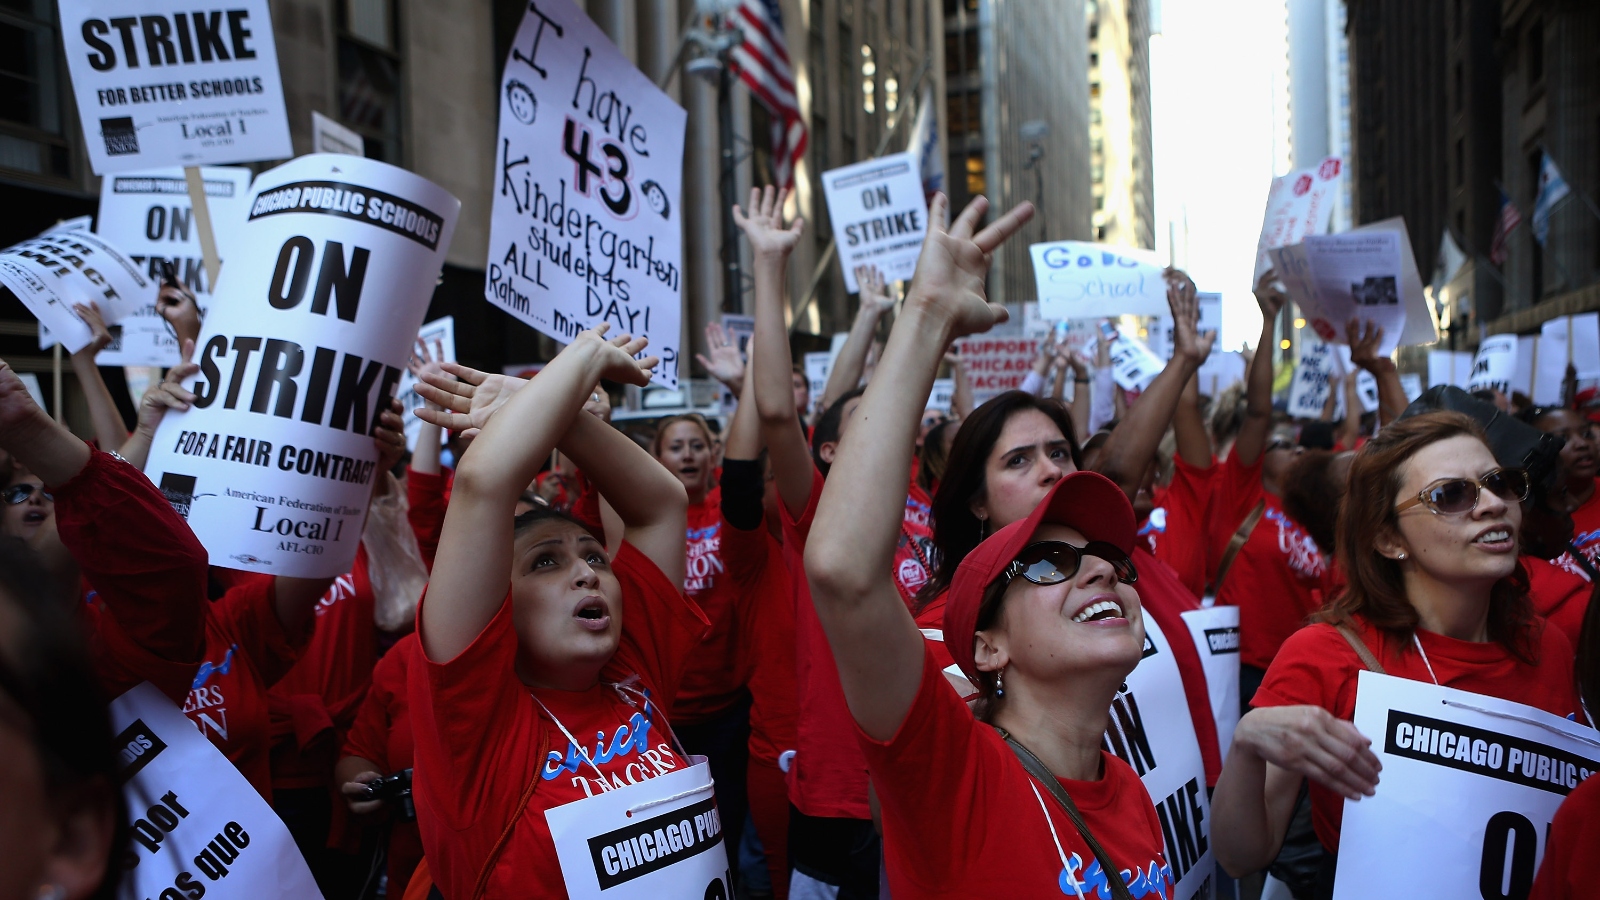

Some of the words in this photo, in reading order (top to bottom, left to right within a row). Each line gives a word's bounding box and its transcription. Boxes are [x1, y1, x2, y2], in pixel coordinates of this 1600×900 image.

[81, 10, 257, 72] STRIKE
[512, 2, 563, 79] I
[98, 89, 127, 106] FOR
[131, 82, 187, 103] BETTER
[190, 77, 263, 99] SCHOOLS
[572, 47, 650, 158] have
[181, 119, 232, 139] Local
[239, 118, 246, 135] 1
[562, 114, 639, 221] 43
[146, 205, 192, 241] ON
[252, 187, 301, 217] CHICAGO
[299, 186, 366, 215] PUBLIC
[367, 196, 439, 244] SCHOOLS
[501, 138, 678, 293] Kindergarten
[861, 184, 891, 211] ON
[845, 209, 922, 247] STRIKE
[268, 235, 371, 324] ON
[504, 243, 550, 291] ALL
[586, 286, 651, 341] DAY!
[528, 226, 631, 303] students
[1047, 267, 1150, 304] School
[961, 342, 1038, 355] SUPPORT
[194, 334, 401, 438] STRIKE
[174, 430, 207, 457] FOR
[206, 436, 218, 458] A
[222, 435, 273, 468] FAIR
[278, 445, 377, 486] CONTRACT
[223, 486, 275, 505] American
[279, 496, 333, 515] Federation
[251, 505, 332, 542] Local
[334, 518, 344, 542] 1
[276, 541, 324, 555] AFL-CIO
[1395, 722, 1504, 770] CHICAGO
[1507, 747, 1577, 789] PUBLIC
[129, 790, 190, 854] por
[194, 820, 250, 881] que
[601, 819, 695, 876] CHICAGO
